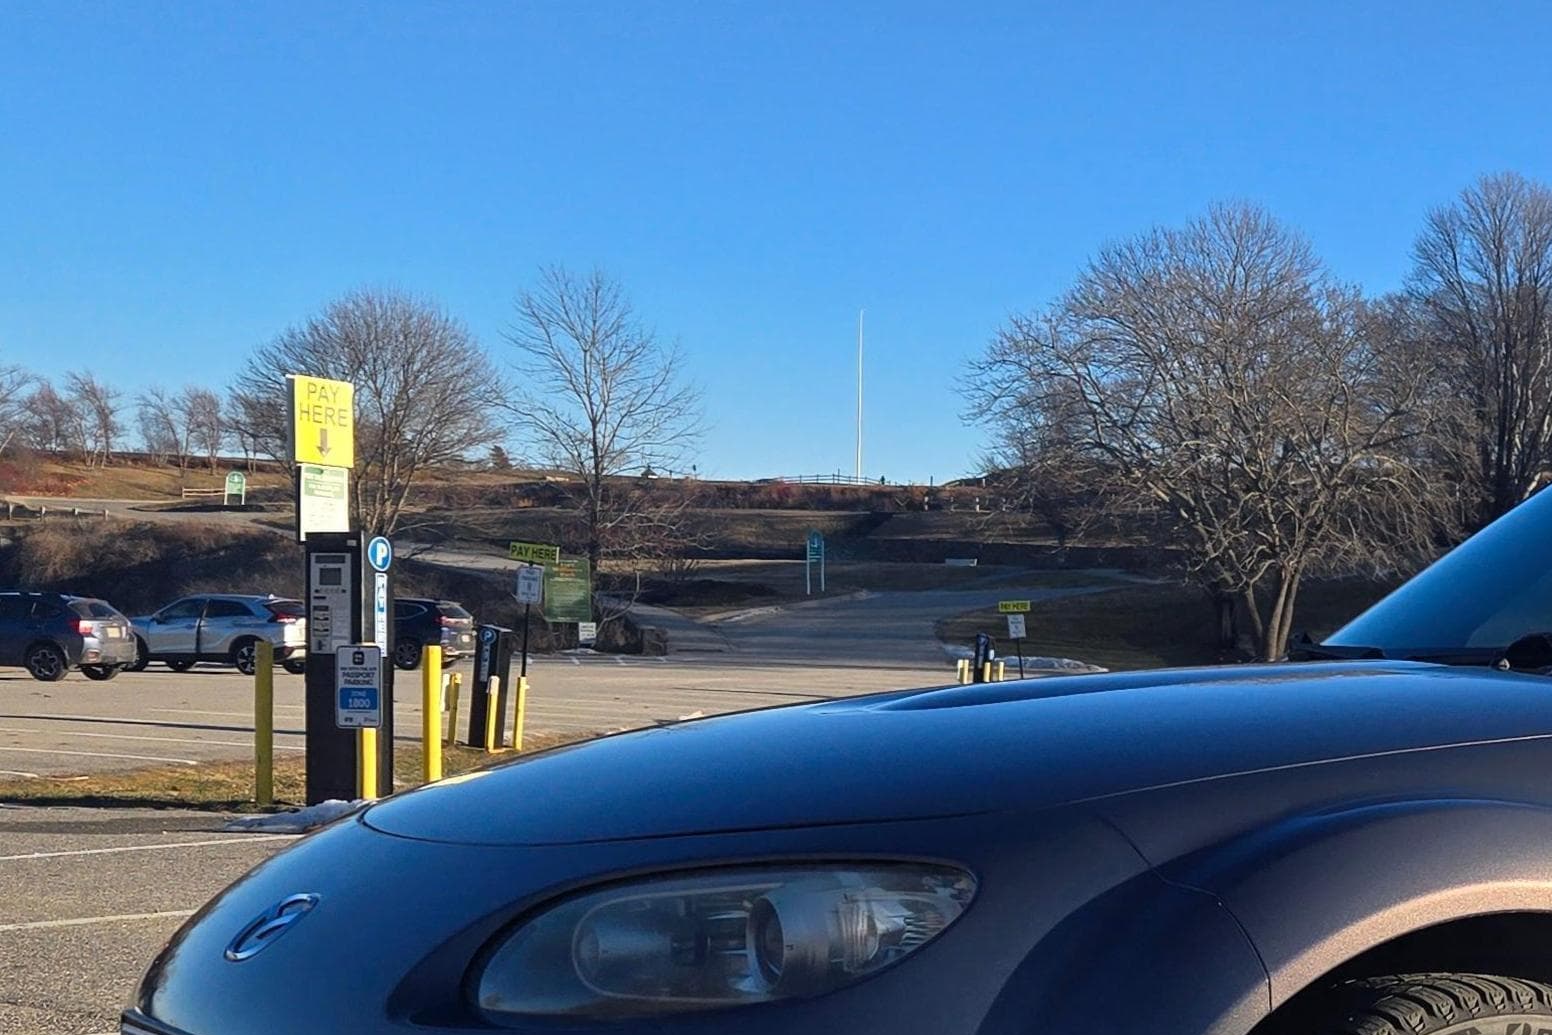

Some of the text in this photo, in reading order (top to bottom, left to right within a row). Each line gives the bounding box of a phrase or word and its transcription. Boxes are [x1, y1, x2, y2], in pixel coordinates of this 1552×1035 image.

[307, 382, 339, 403] PAY
[299, 402, 348, 427] HERE
[376, 542, 388, 566] P
[511, 544, 556, 560] PAY HERE
